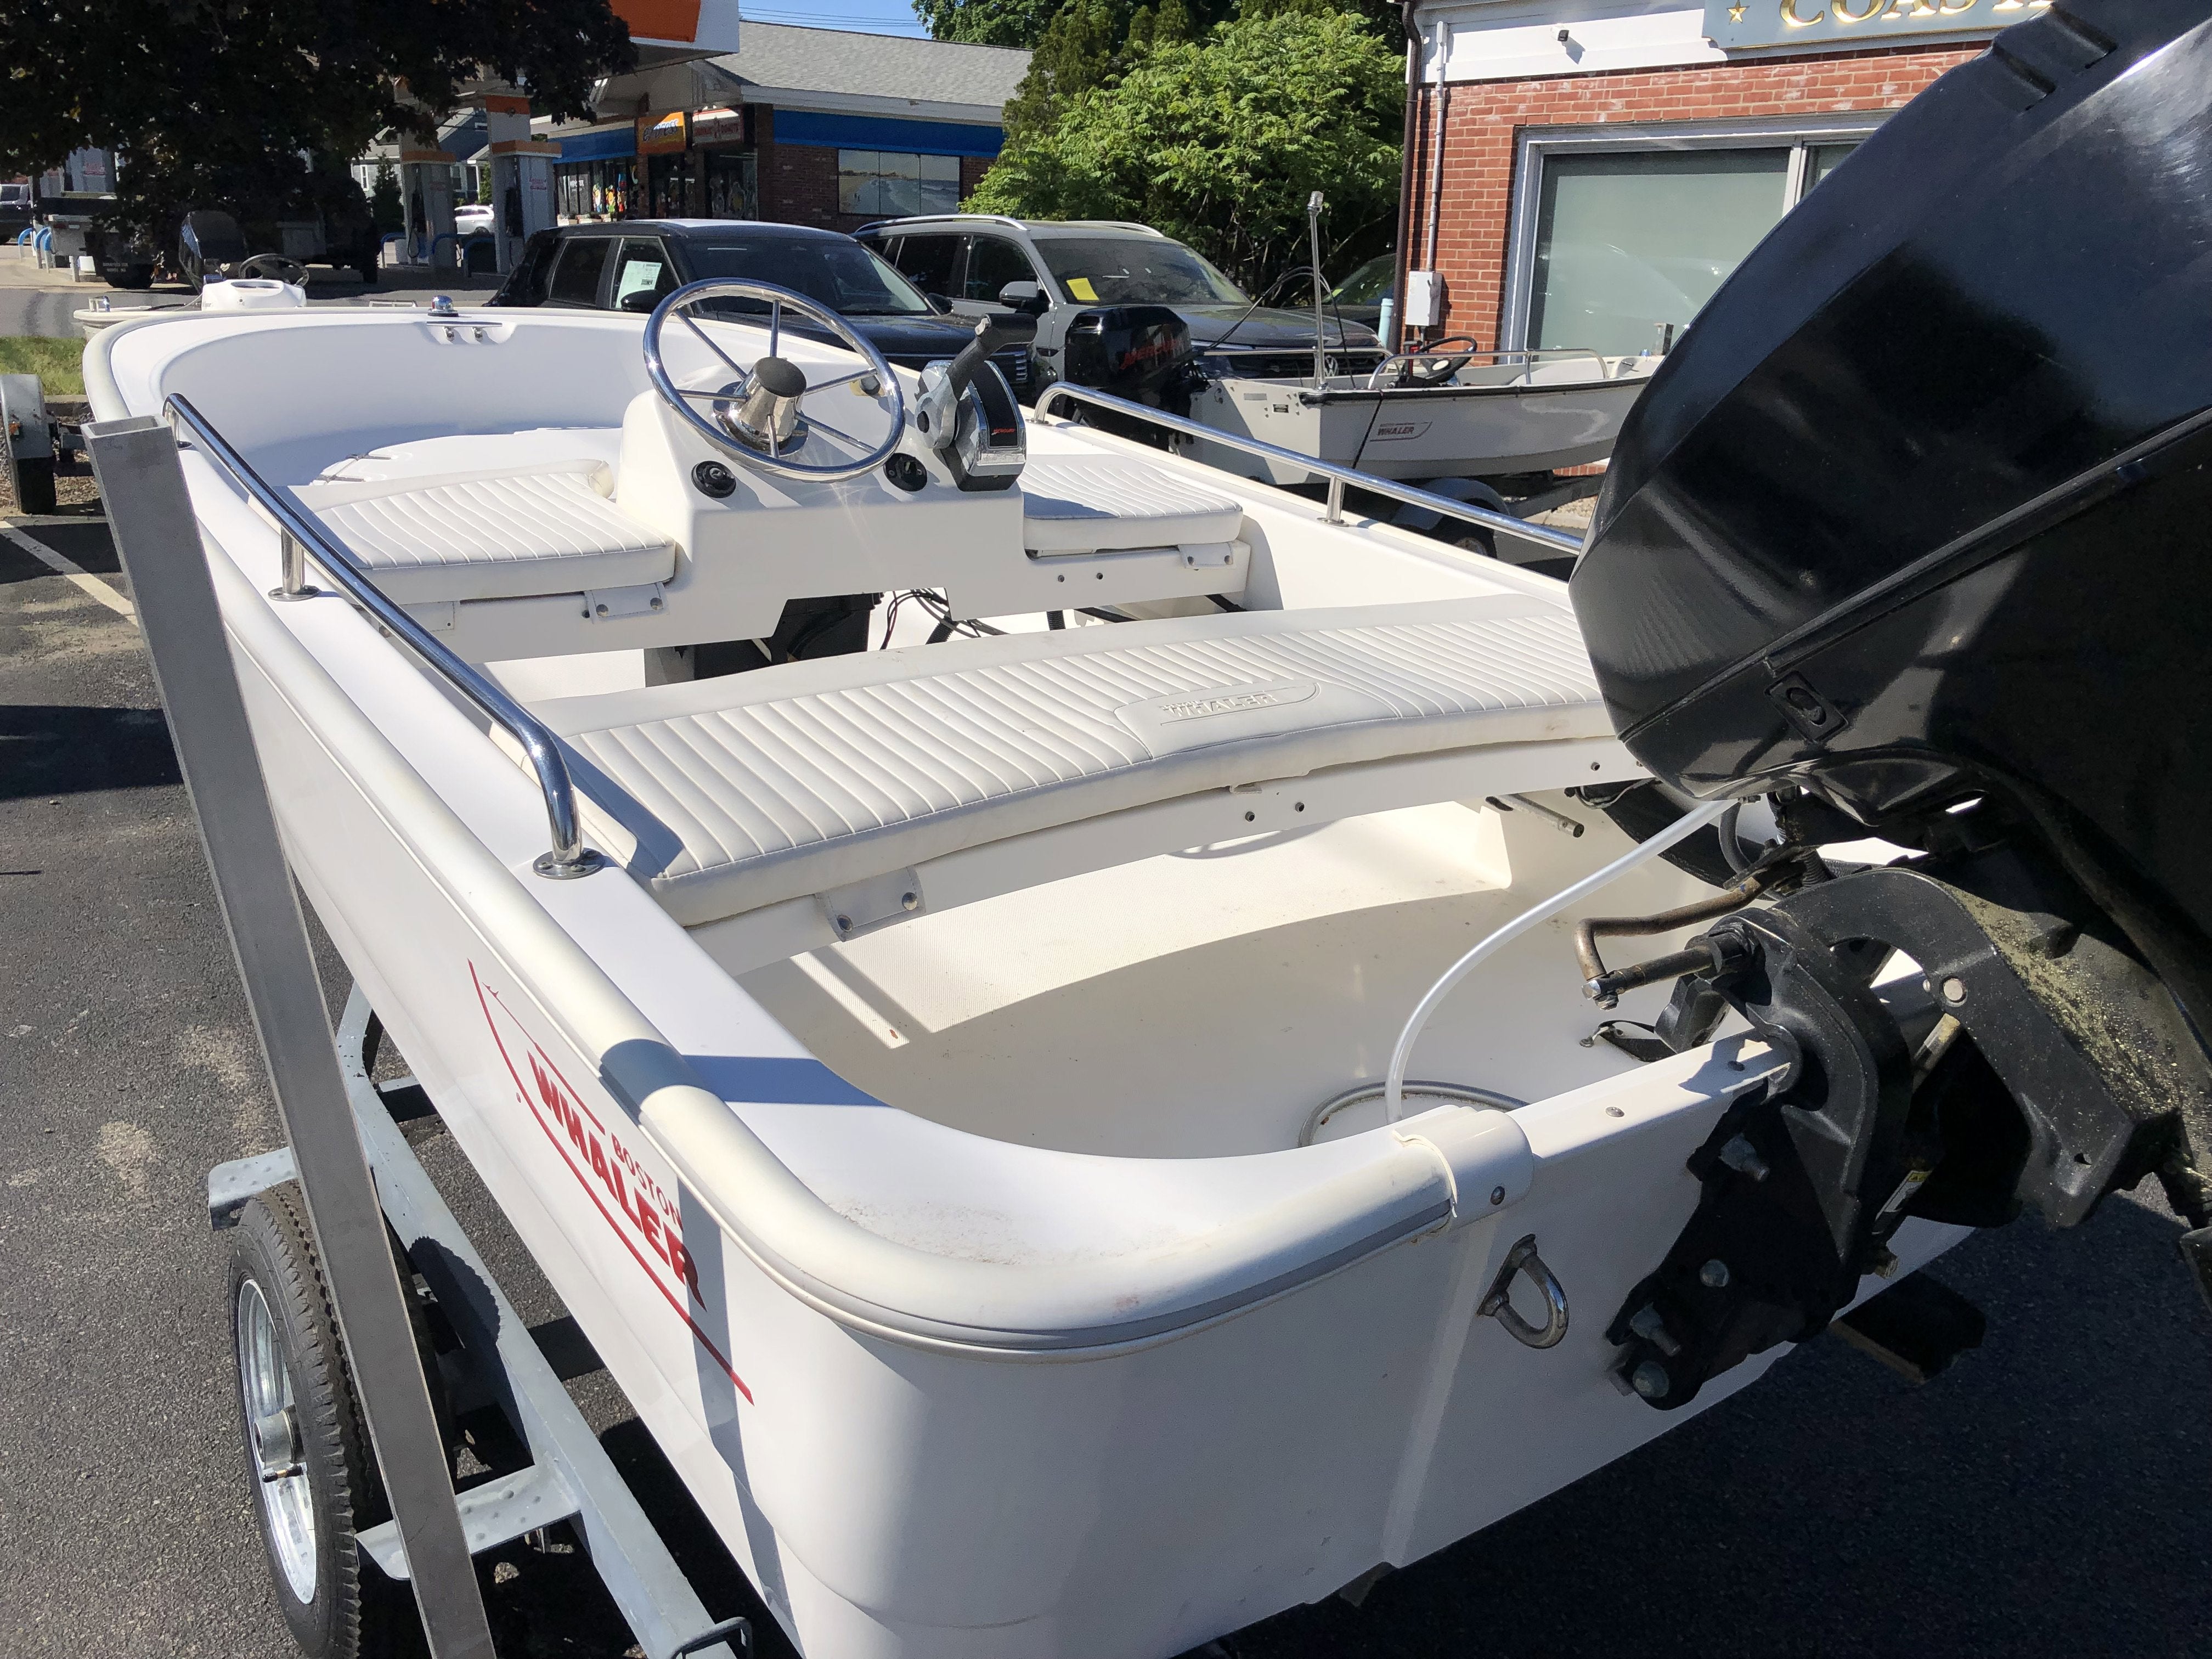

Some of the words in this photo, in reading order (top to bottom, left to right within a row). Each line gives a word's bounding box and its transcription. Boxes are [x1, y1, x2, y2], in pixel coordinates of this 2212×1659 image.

[1378, 426, 1414, 436] WHALER
[1163, 693, 1278, 717] WHALER
[527, 1049, 707, 1312] WHALER
[611, 1132, 684, 1233] BOSTON
